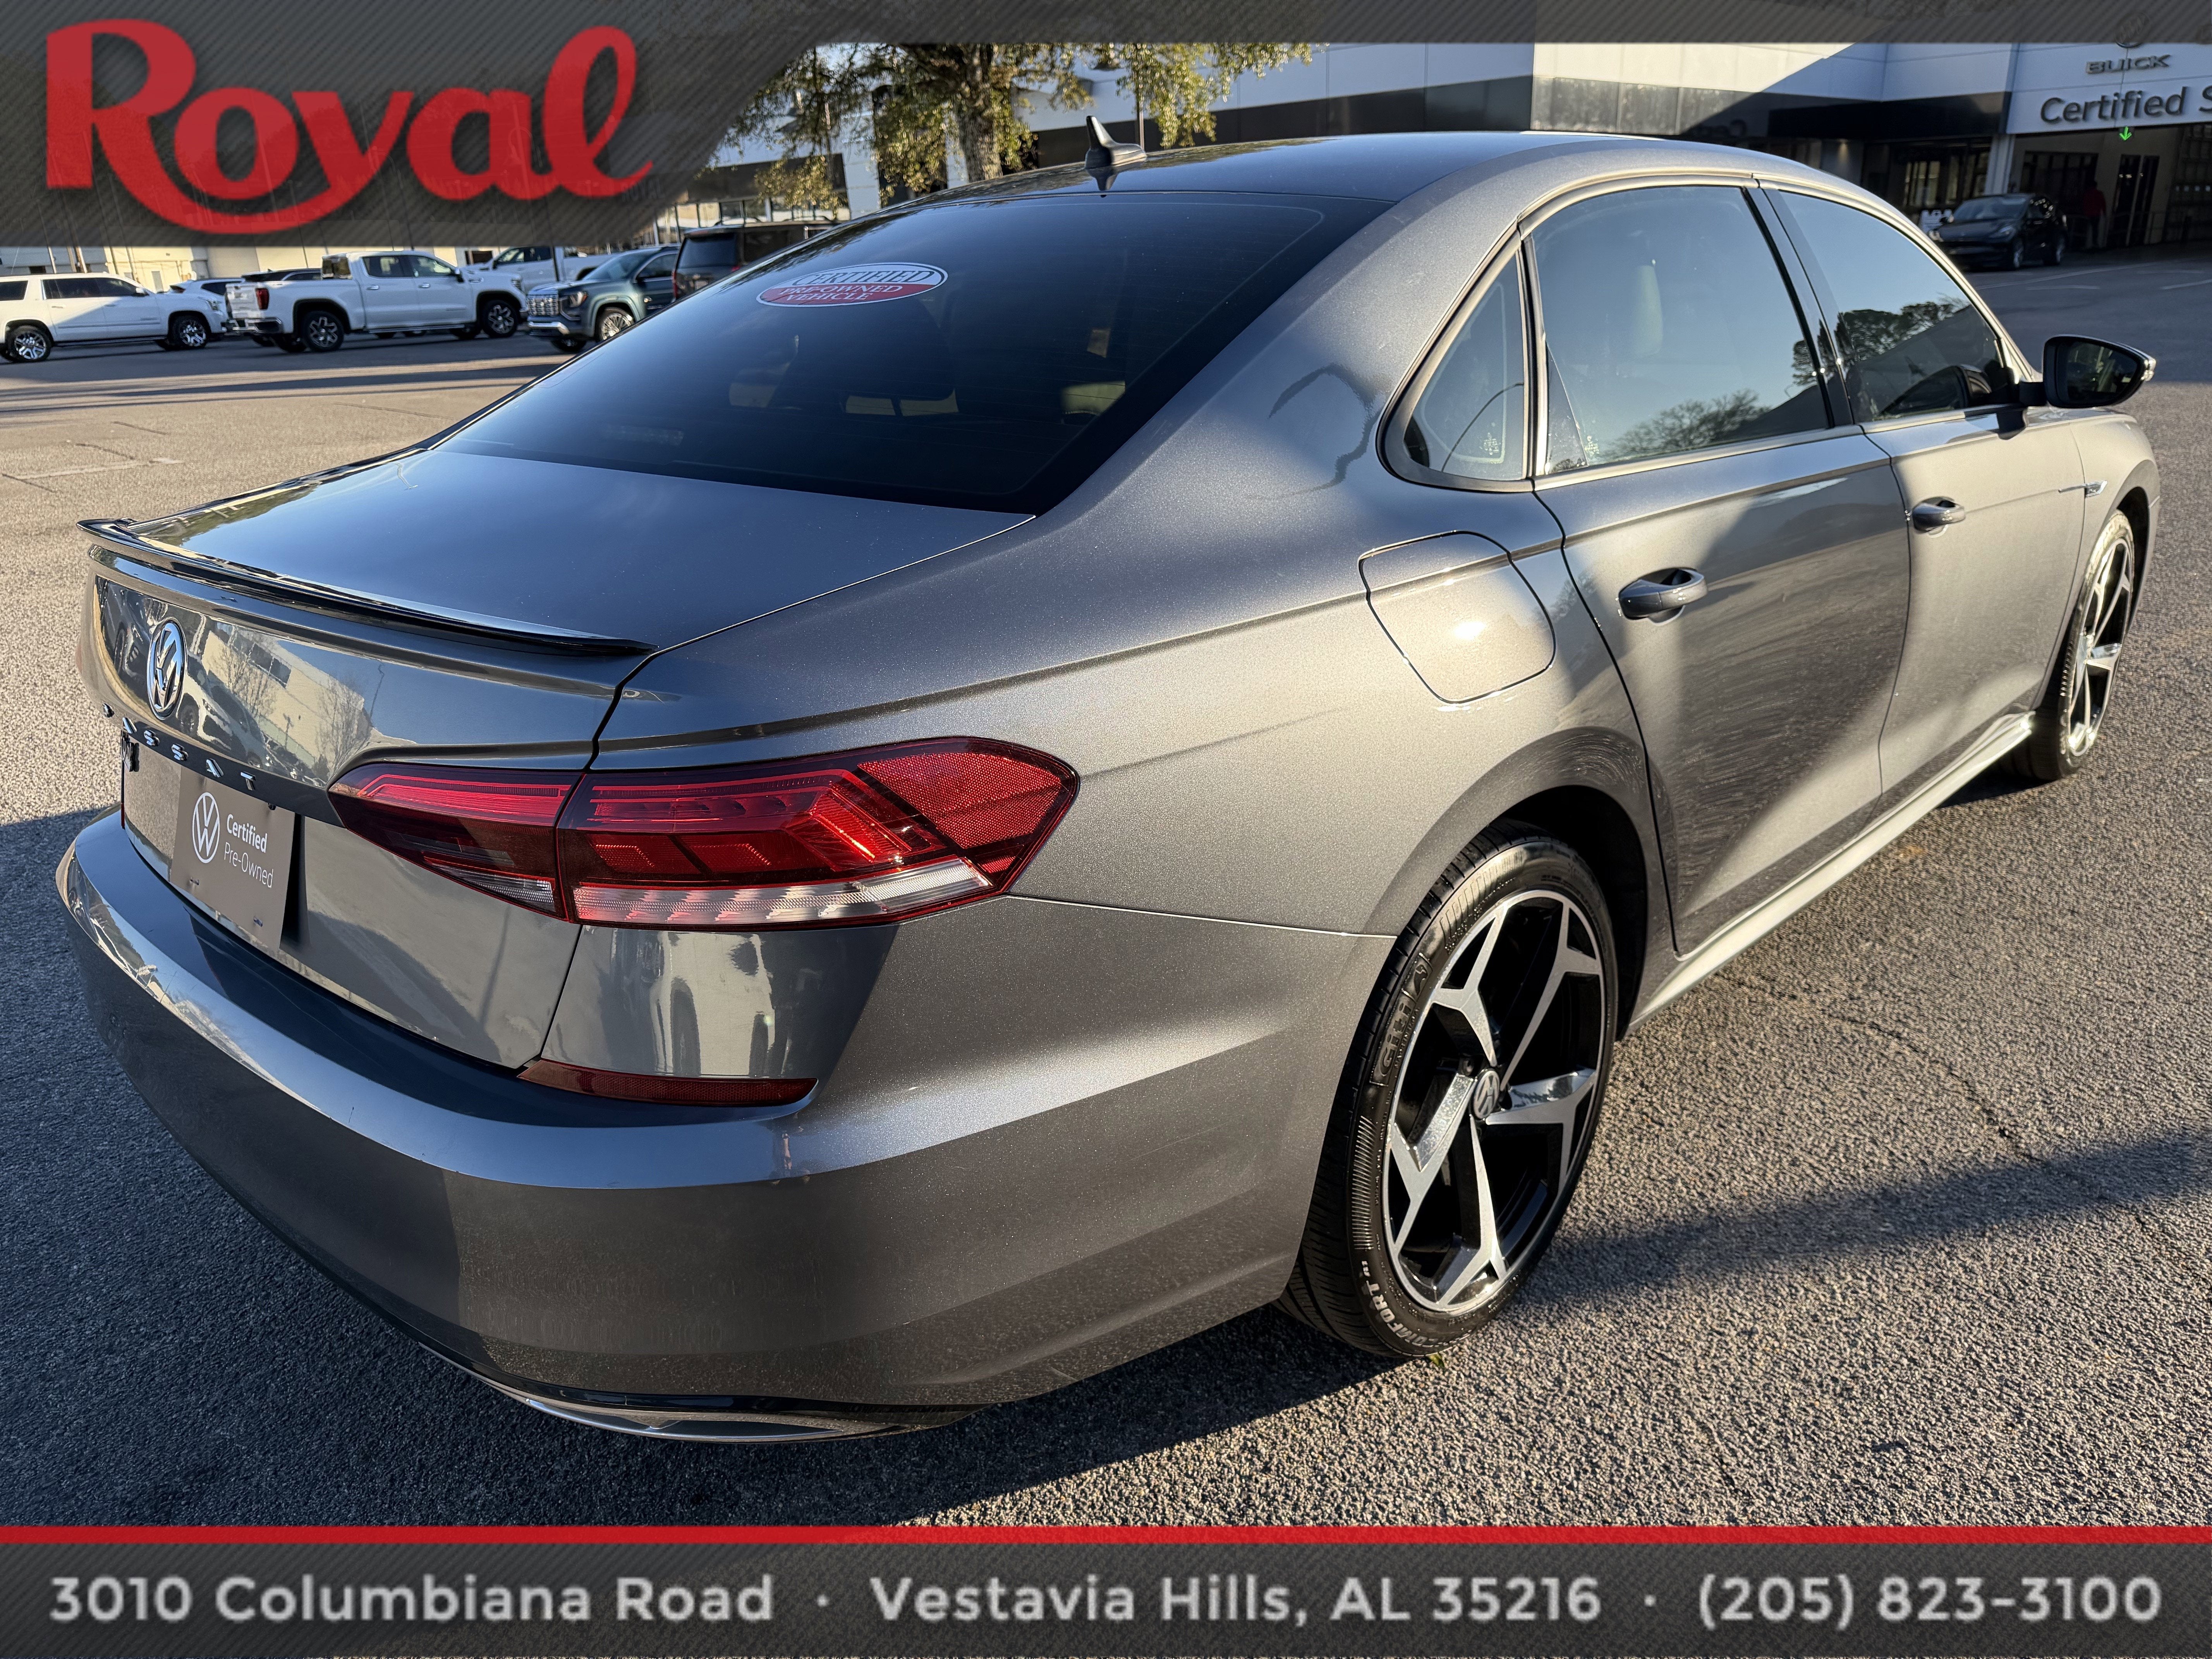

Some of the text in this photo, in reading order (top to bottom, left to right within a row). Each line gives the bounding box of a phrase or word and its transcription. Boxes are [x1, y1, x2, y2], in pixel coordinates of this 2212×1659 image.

[2086, 54, 2171, 74] BUICK
[2040, 86, 2189, 124] Certified
[792, 270, 935, 286] CERTIFIED
[227, 814, 268, 853] Certified
[224, 842, 274, 888] Pre-Owned
